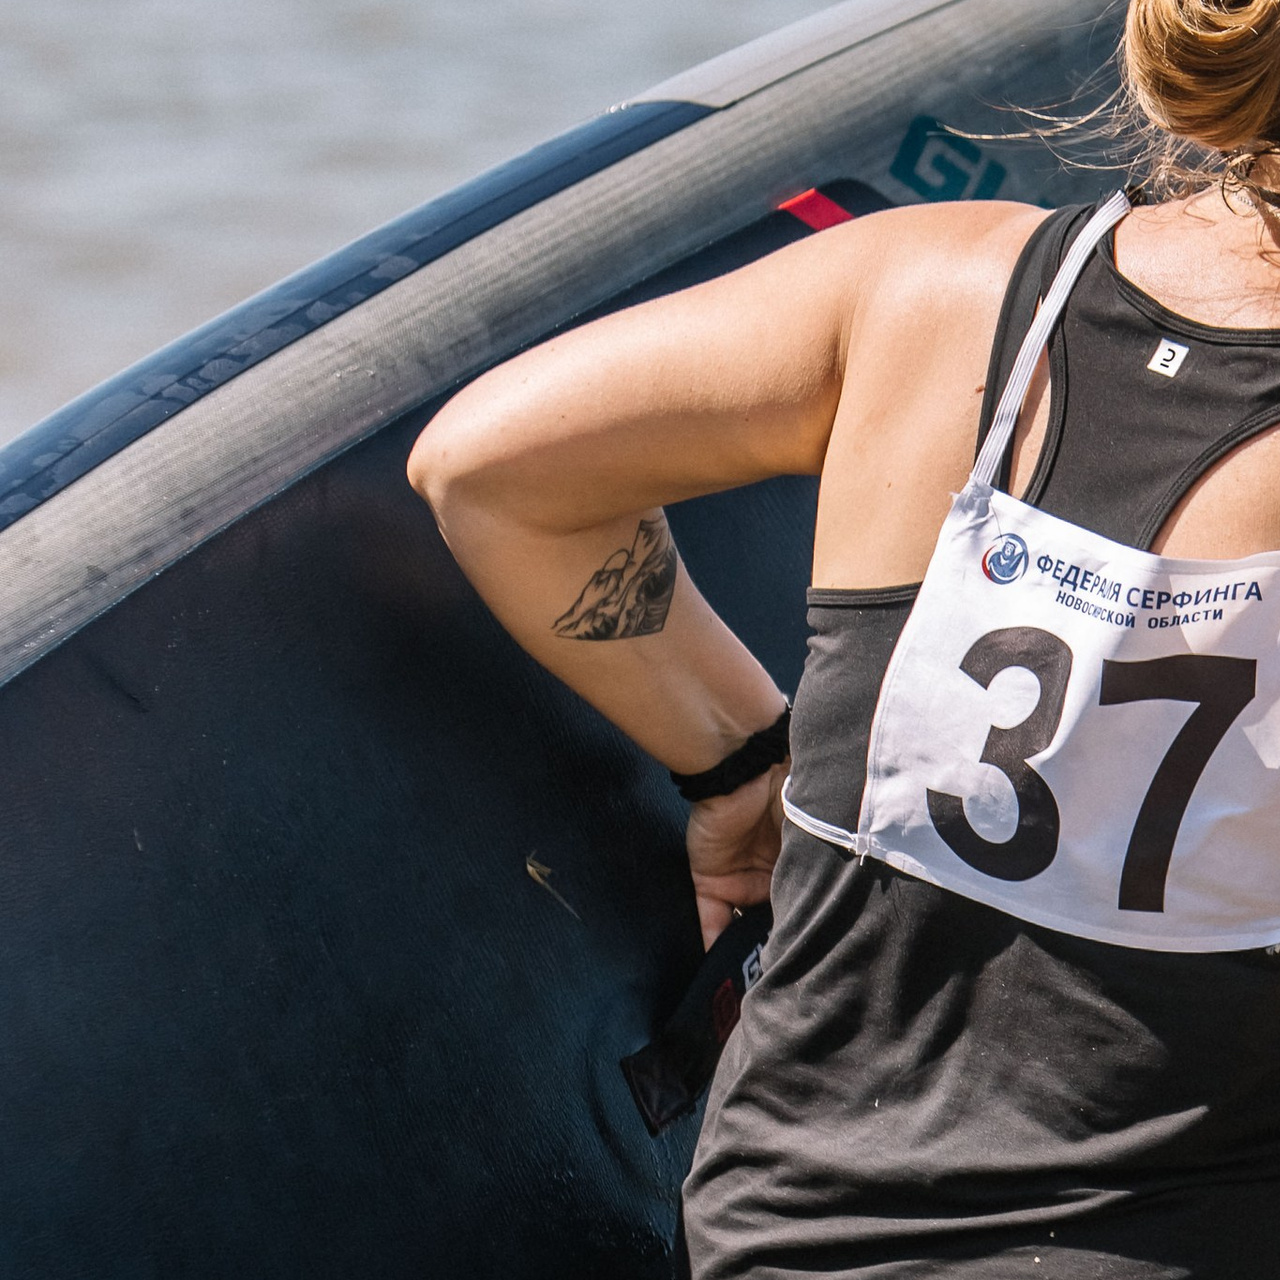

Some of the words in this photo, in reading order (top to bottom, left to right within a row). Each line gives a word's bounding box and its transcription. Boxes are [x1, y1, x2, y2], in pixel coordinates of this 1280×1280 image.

[1126, 580, 1263, 611] СЕРФИНГА
[1147, 608, 1224, 629] ОБЛАСТИ
[926, 626, 1257, 913] 37
